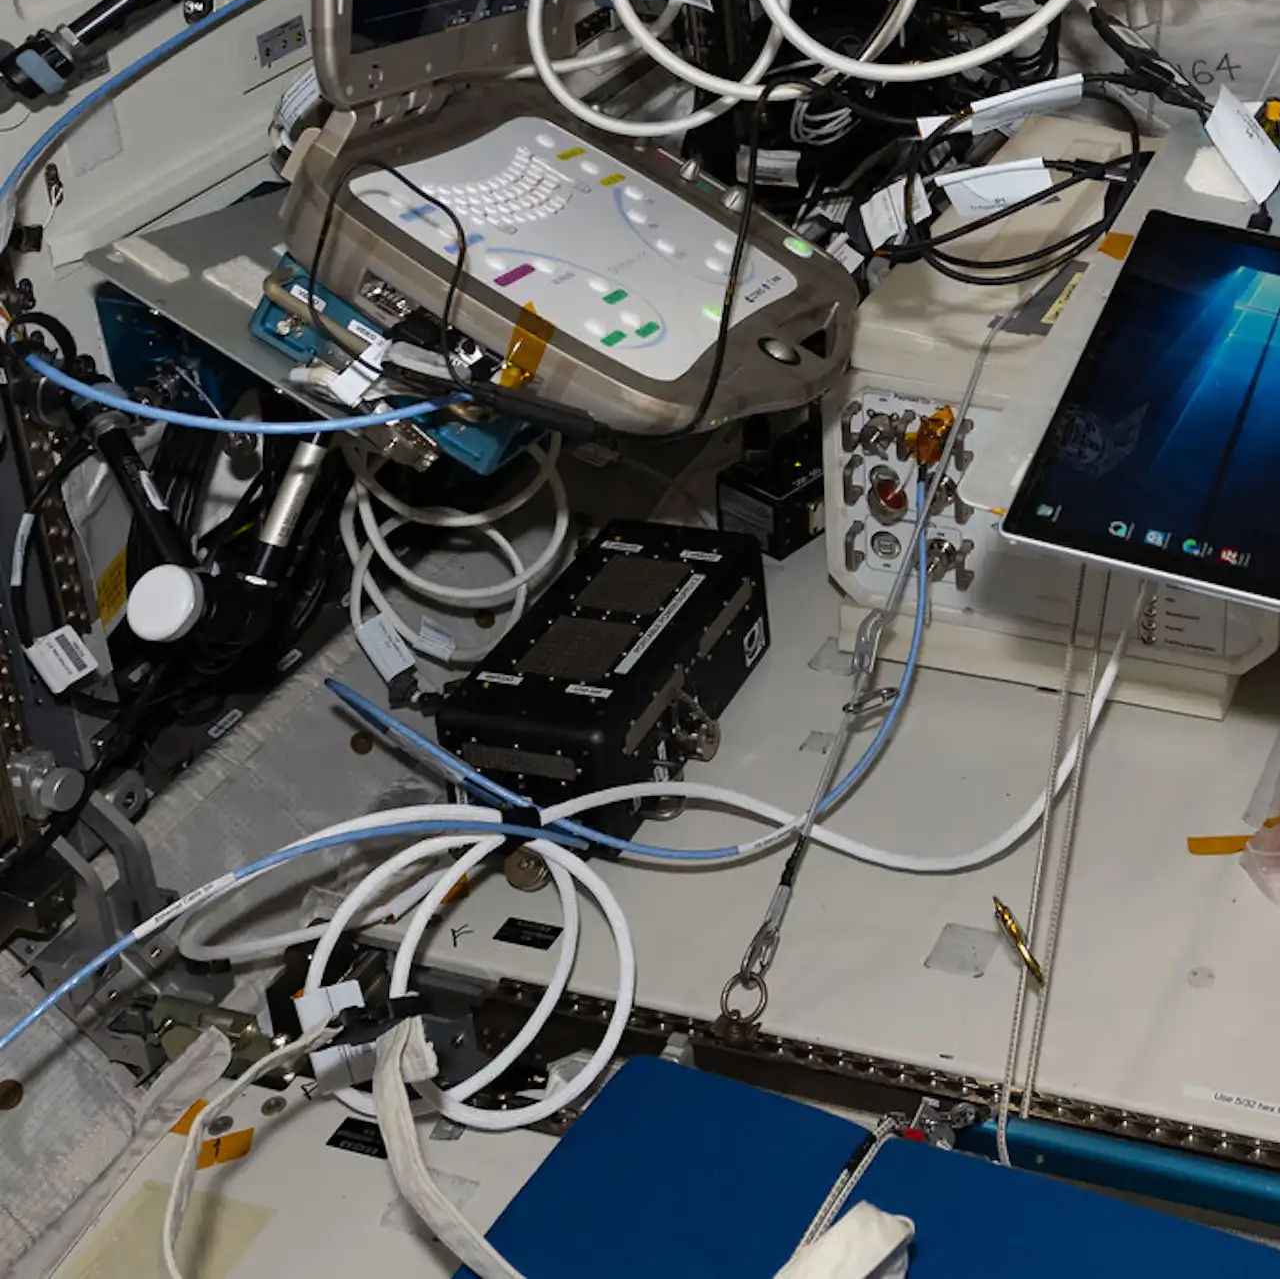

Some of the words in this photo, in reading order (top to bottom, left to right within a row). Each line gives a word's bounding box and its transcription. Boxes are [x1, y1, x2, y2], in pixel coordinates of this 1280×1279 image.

[1214, 1092, 1233, 1103] Use
[1234, 1096, 1257, 1109] 5/32
[1257, 1102, 1275, 1113] hex
